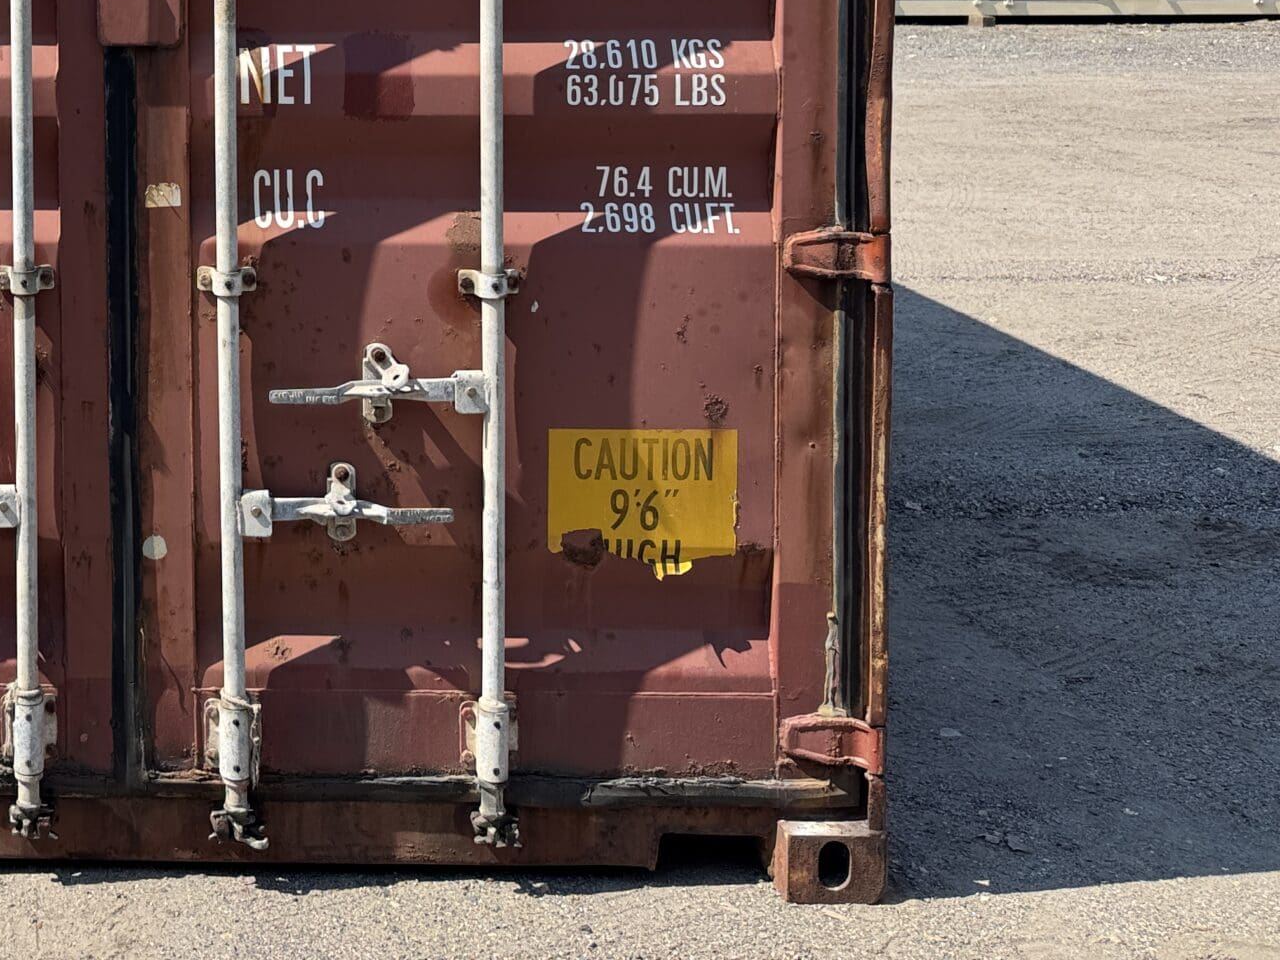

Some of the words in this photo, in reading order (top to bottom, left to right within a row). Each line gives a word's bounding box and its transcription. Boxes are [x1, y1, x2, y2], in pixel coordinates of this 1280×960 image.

[670, 38, 725, 69] KGS
[239, 44, 316, 104] NET
[675, 74, 727, 106] LBS
[595, 166, 653, 198] 76.4
[668, 166, 733, 198] CU.M.
[670, 203, 740, 234] CU.FT.
[573, 437, 714, 481] CAUTION
